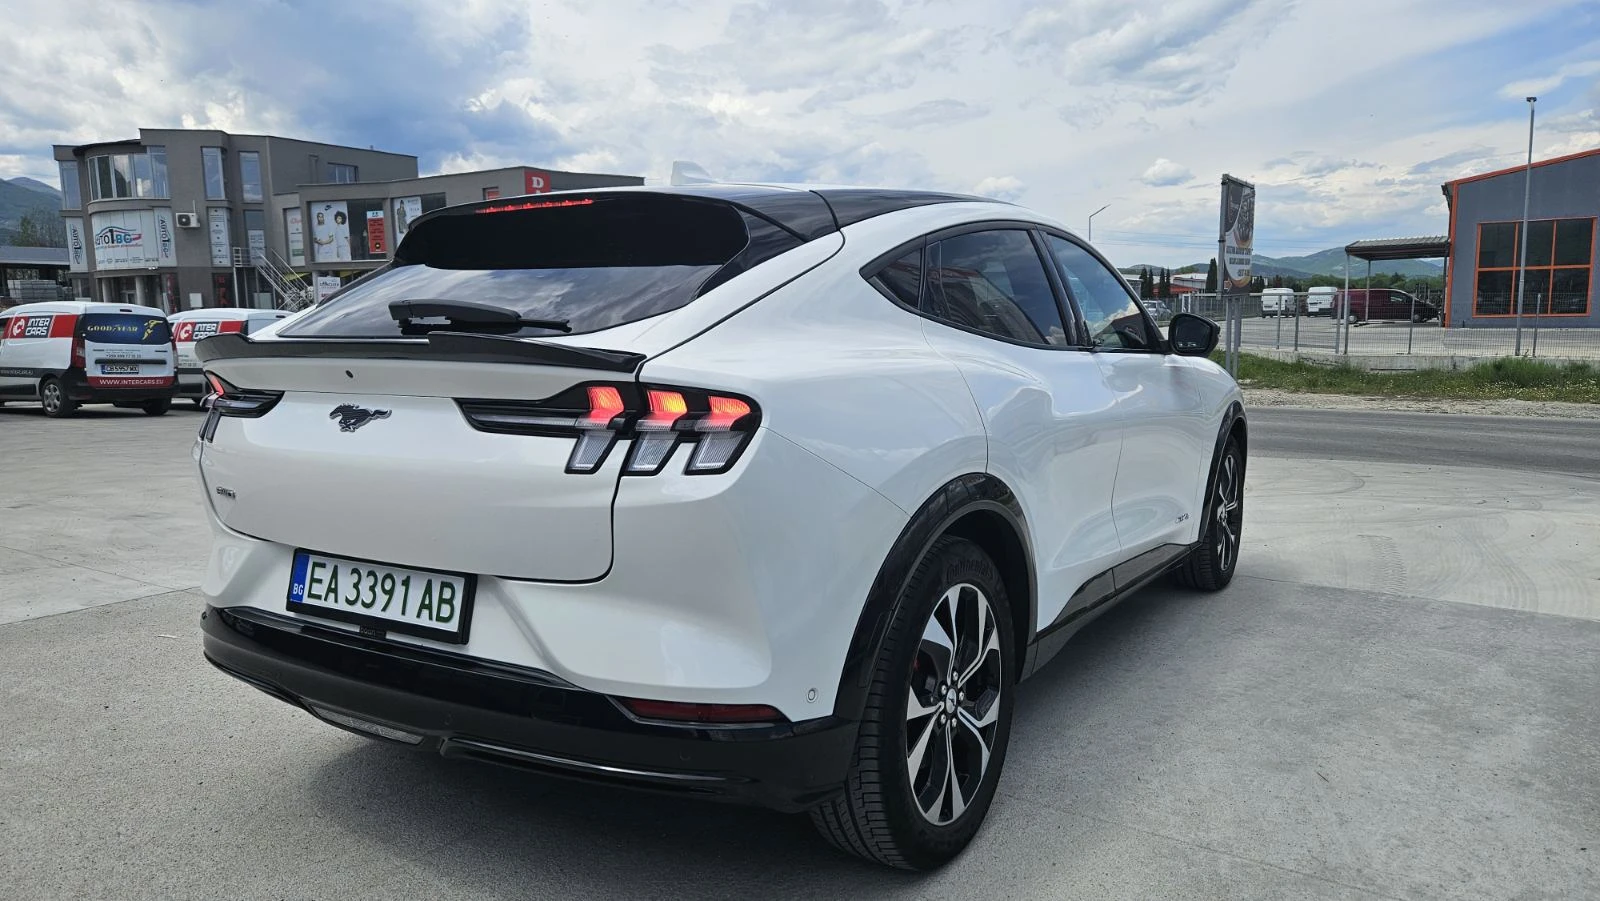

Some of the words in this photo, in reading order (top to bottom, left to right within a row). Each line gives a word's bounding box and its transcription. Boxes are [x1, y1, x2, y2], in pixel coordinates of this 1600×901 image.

[28, 318, 50, 326] INTER
[25, 327, 47, 336] CARS
[195, 323, 217, 331] INTER
[292, 583, 304, 596] BG
[307, 561, 339, 604] EA
[344, 567, 412, 616] 3391
[416, 578, 457, 624] AB
